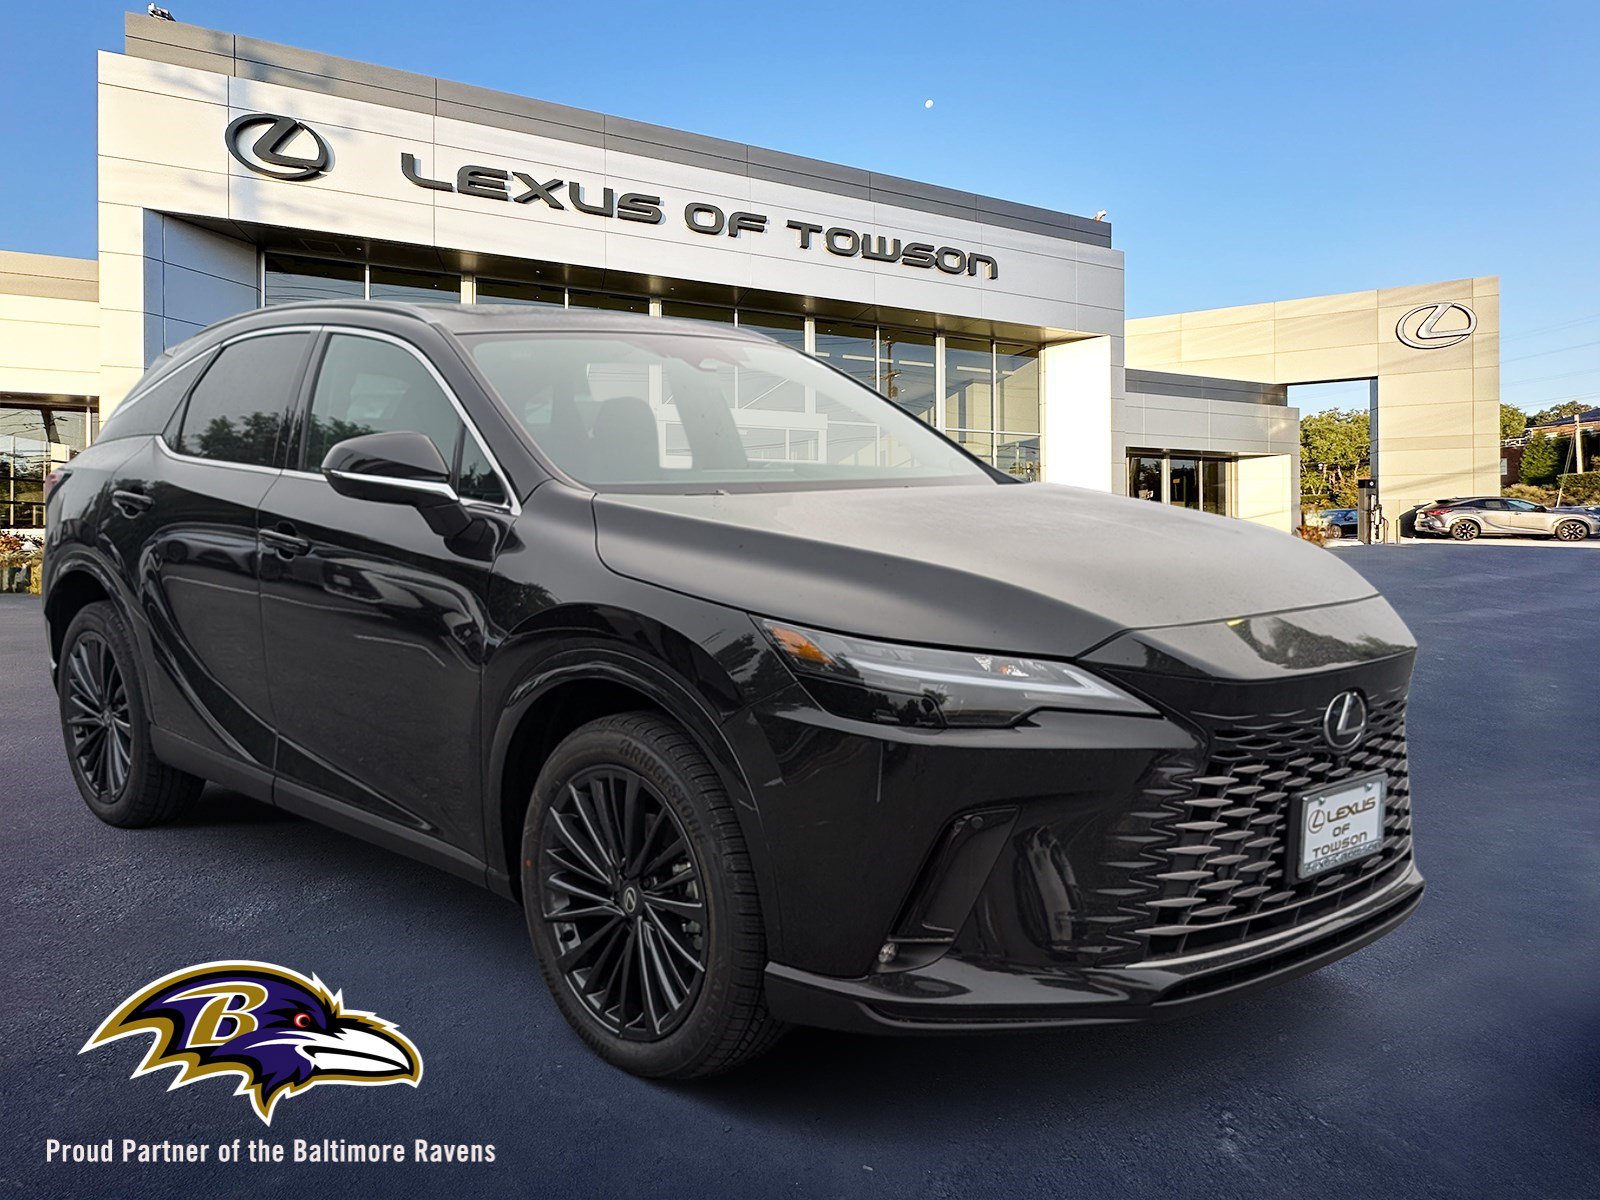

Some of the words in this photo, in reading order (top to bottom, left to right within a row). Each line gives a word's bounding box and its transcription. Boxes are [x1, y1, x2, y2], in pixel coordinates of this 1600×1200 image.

[400, 152, 663, 225] LEXUS
[684, 202, 768, 237] OF
[786, 219, 999, 280] TOWSON
[617, 738, 709, 846] BRIDGESTONE
[1326, 797, 1376, 822] LEXUS
[1332, 823, 1351, 837] OF
[1312, 831, 1368, 858] TOWSON
